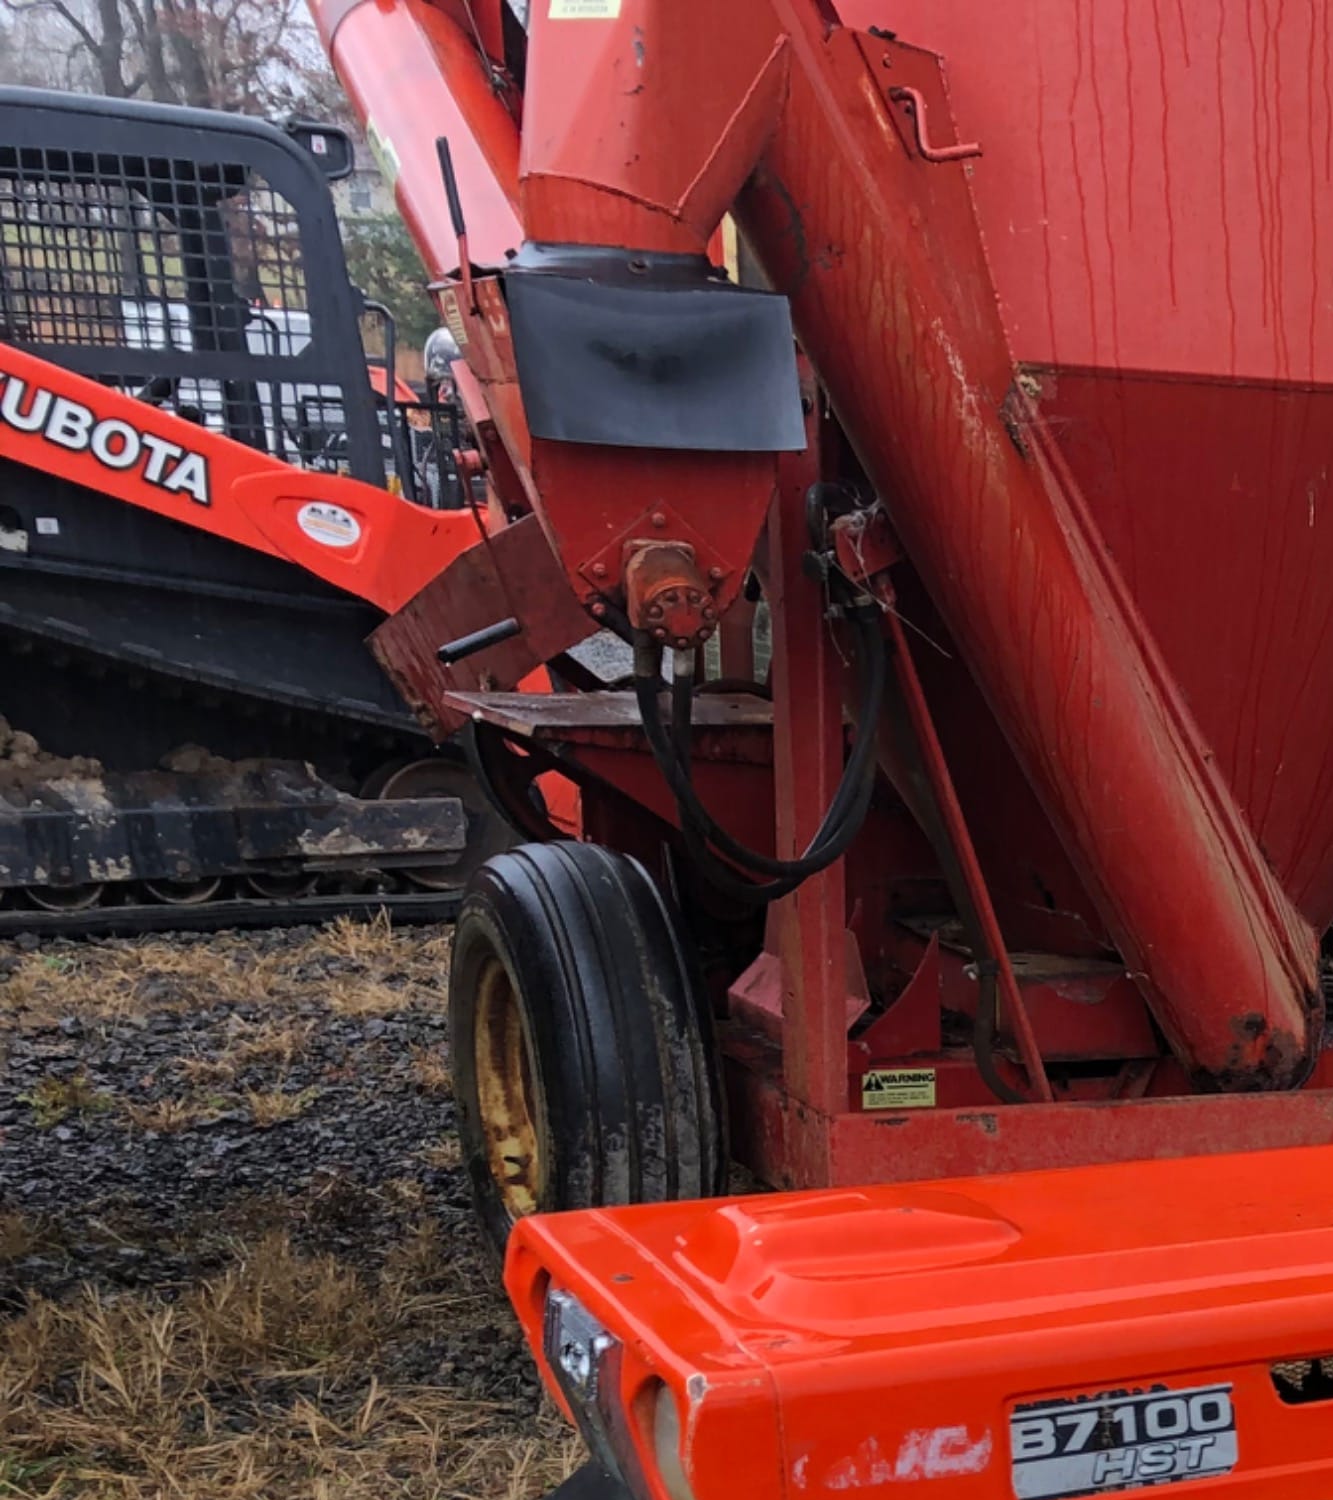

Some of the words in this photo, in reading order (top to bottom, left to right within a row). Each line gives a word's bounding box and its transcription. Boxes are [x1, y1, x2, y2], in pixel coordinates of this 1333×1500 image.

[0, 369, 211, 506] UBOTA
[880, 1072, 936, 1084] WARNING
[1010, 1391, 1234, 1461] B7100
[1092, 1434, 1217, 1485] HST
